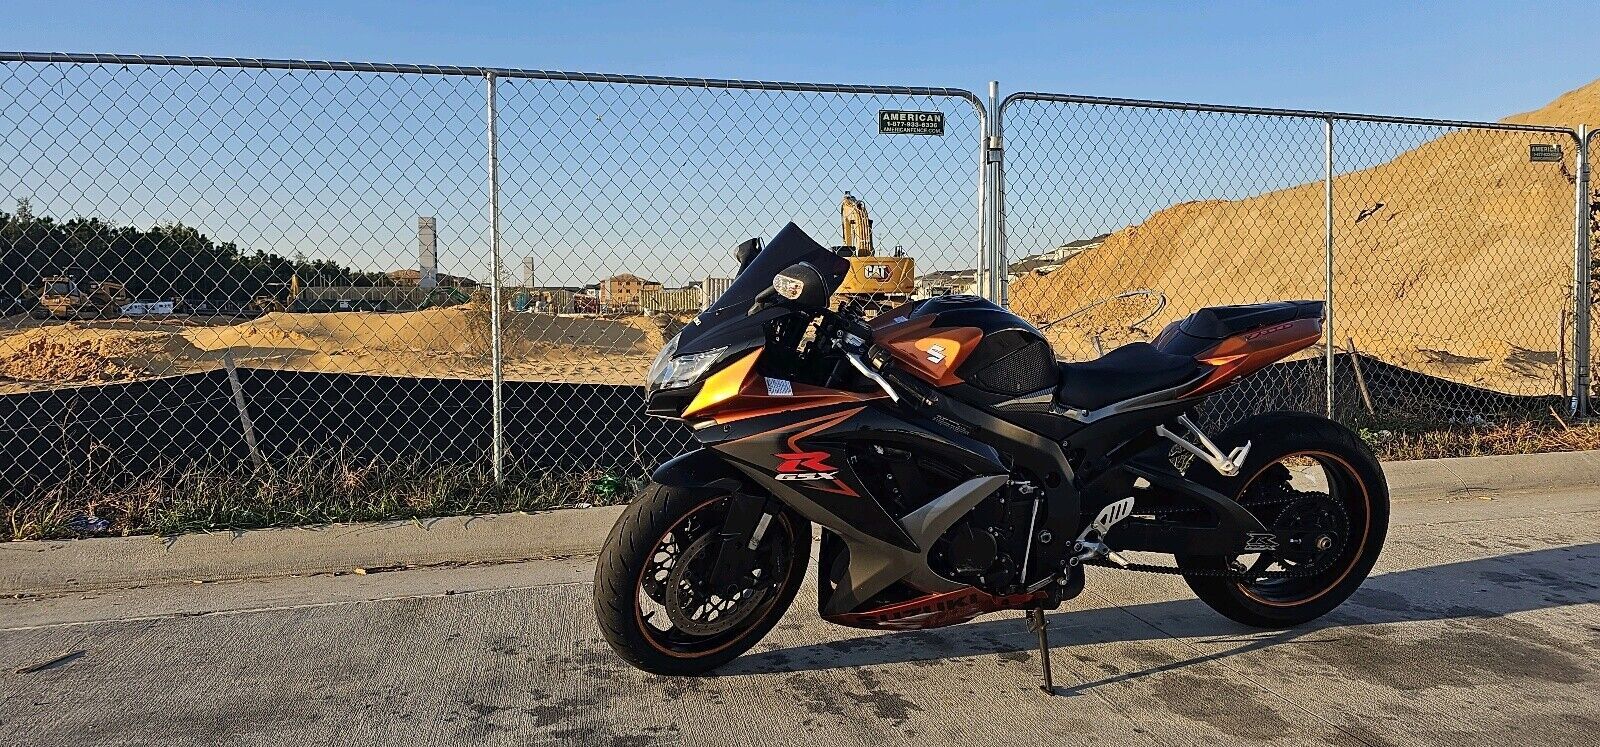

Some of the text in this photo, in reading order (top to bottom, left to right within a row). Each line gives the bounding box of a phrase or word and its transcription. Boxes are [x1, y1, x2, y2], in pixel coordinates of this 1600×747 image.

[883, 113, 941, 122] AMERICAN
[864, 265, 887, 279] CAT
[774, 471, 839, 481] GSX
